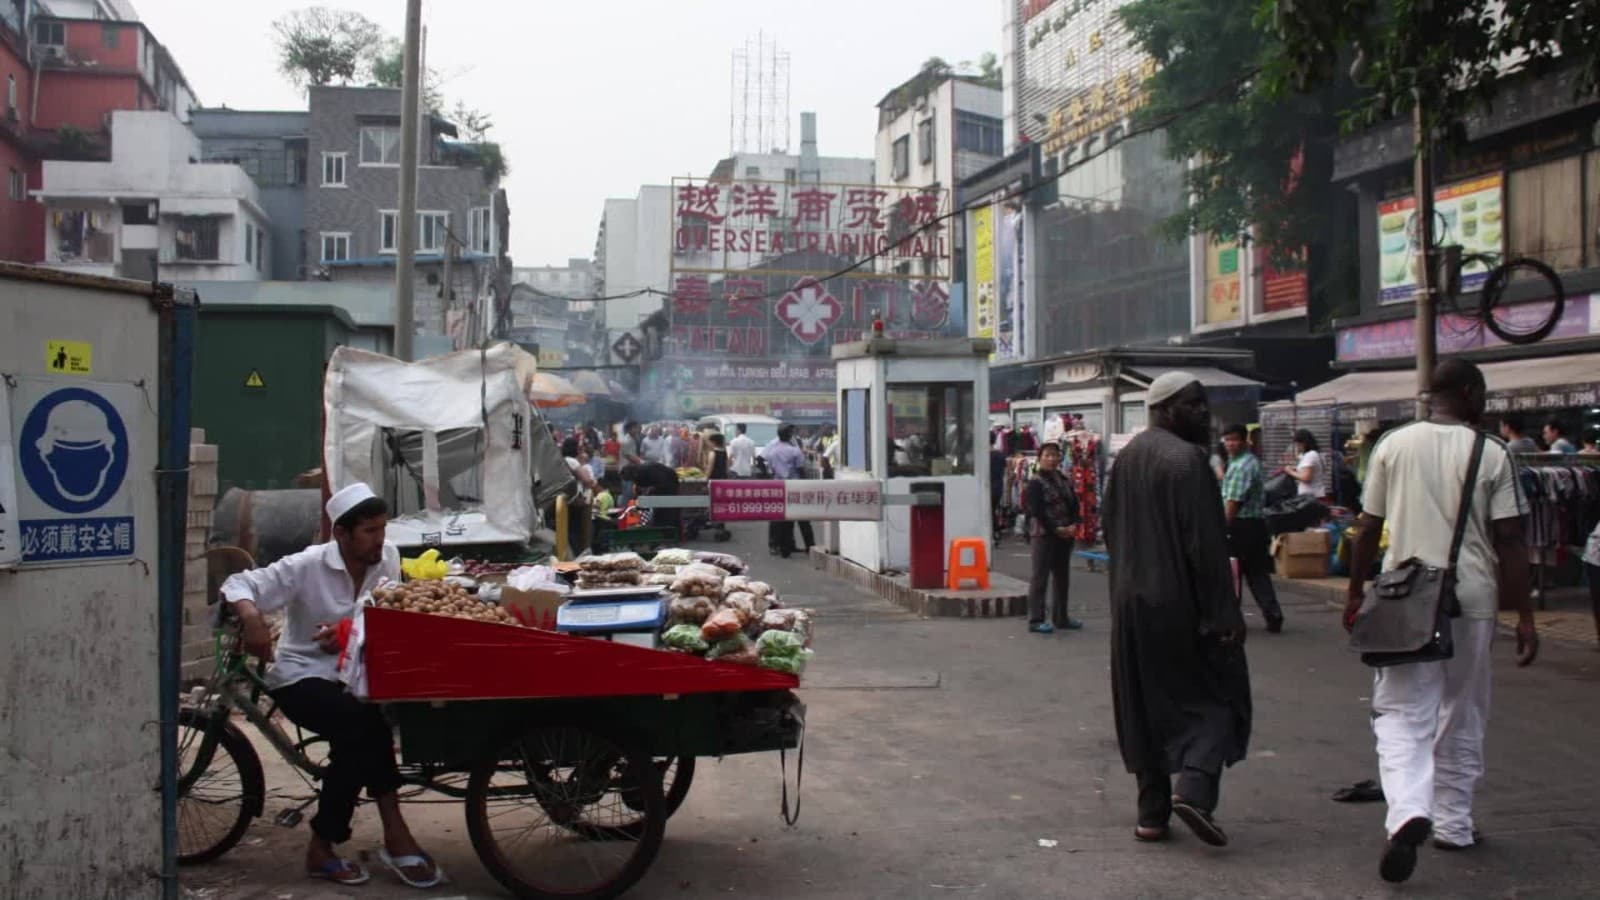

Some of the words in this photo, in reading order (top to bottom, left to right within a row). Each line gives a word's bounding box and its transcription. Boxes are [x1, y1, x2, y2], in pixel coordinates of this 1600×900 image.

[676, 184, 945, 230] 越洋商贸城
[676, 229, 784, 253] OVERSEA
[794, 231, 889, 258] TRADING
[899, 236, 950, 259] MALL
[674, 277, 766, 319] 泰安
[853, 281, 950, 326] 门诊
[23, 522, 131, 555] 必须戴安全帽
